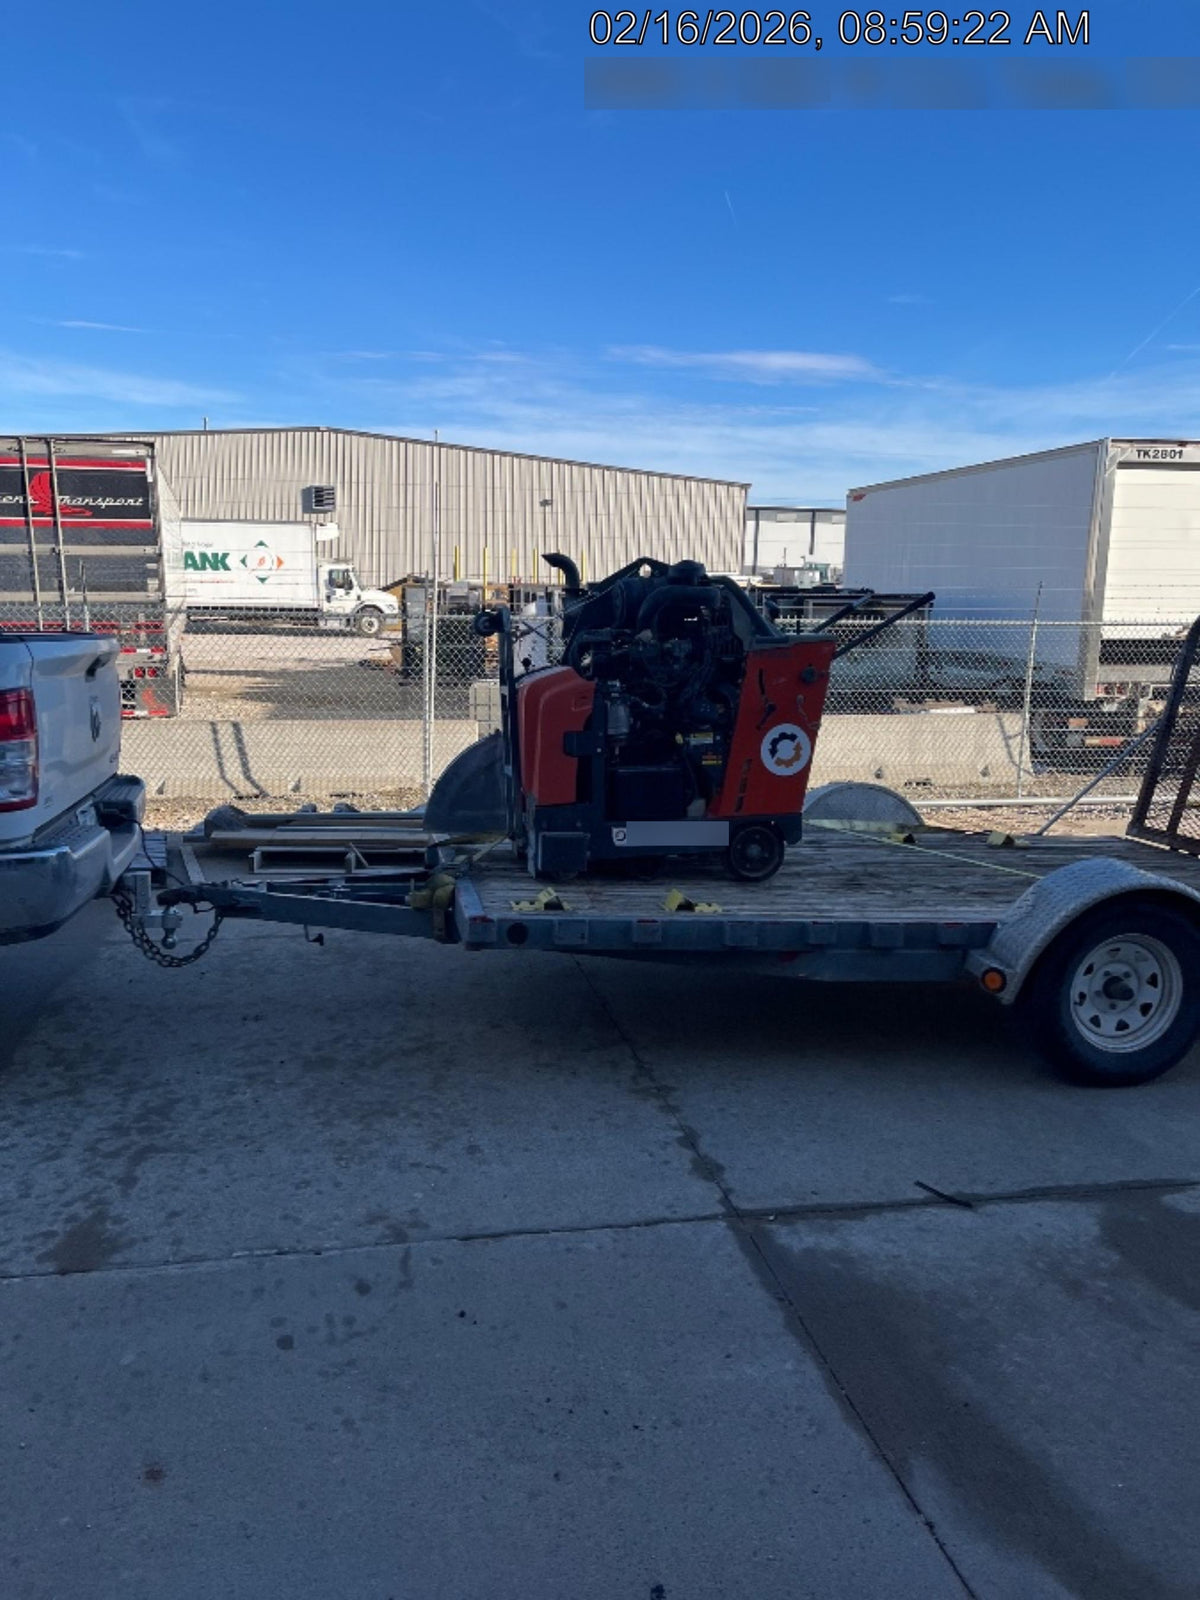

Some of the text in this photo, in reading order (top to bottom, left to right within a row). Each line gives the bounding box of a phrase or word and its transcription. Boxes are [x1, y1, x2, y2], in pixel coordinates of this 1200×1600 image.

[1136, 449, 1183, 459] TK2801
[58, 495, 143, 509] Transport
[183, 551, 231, 571] ANK
